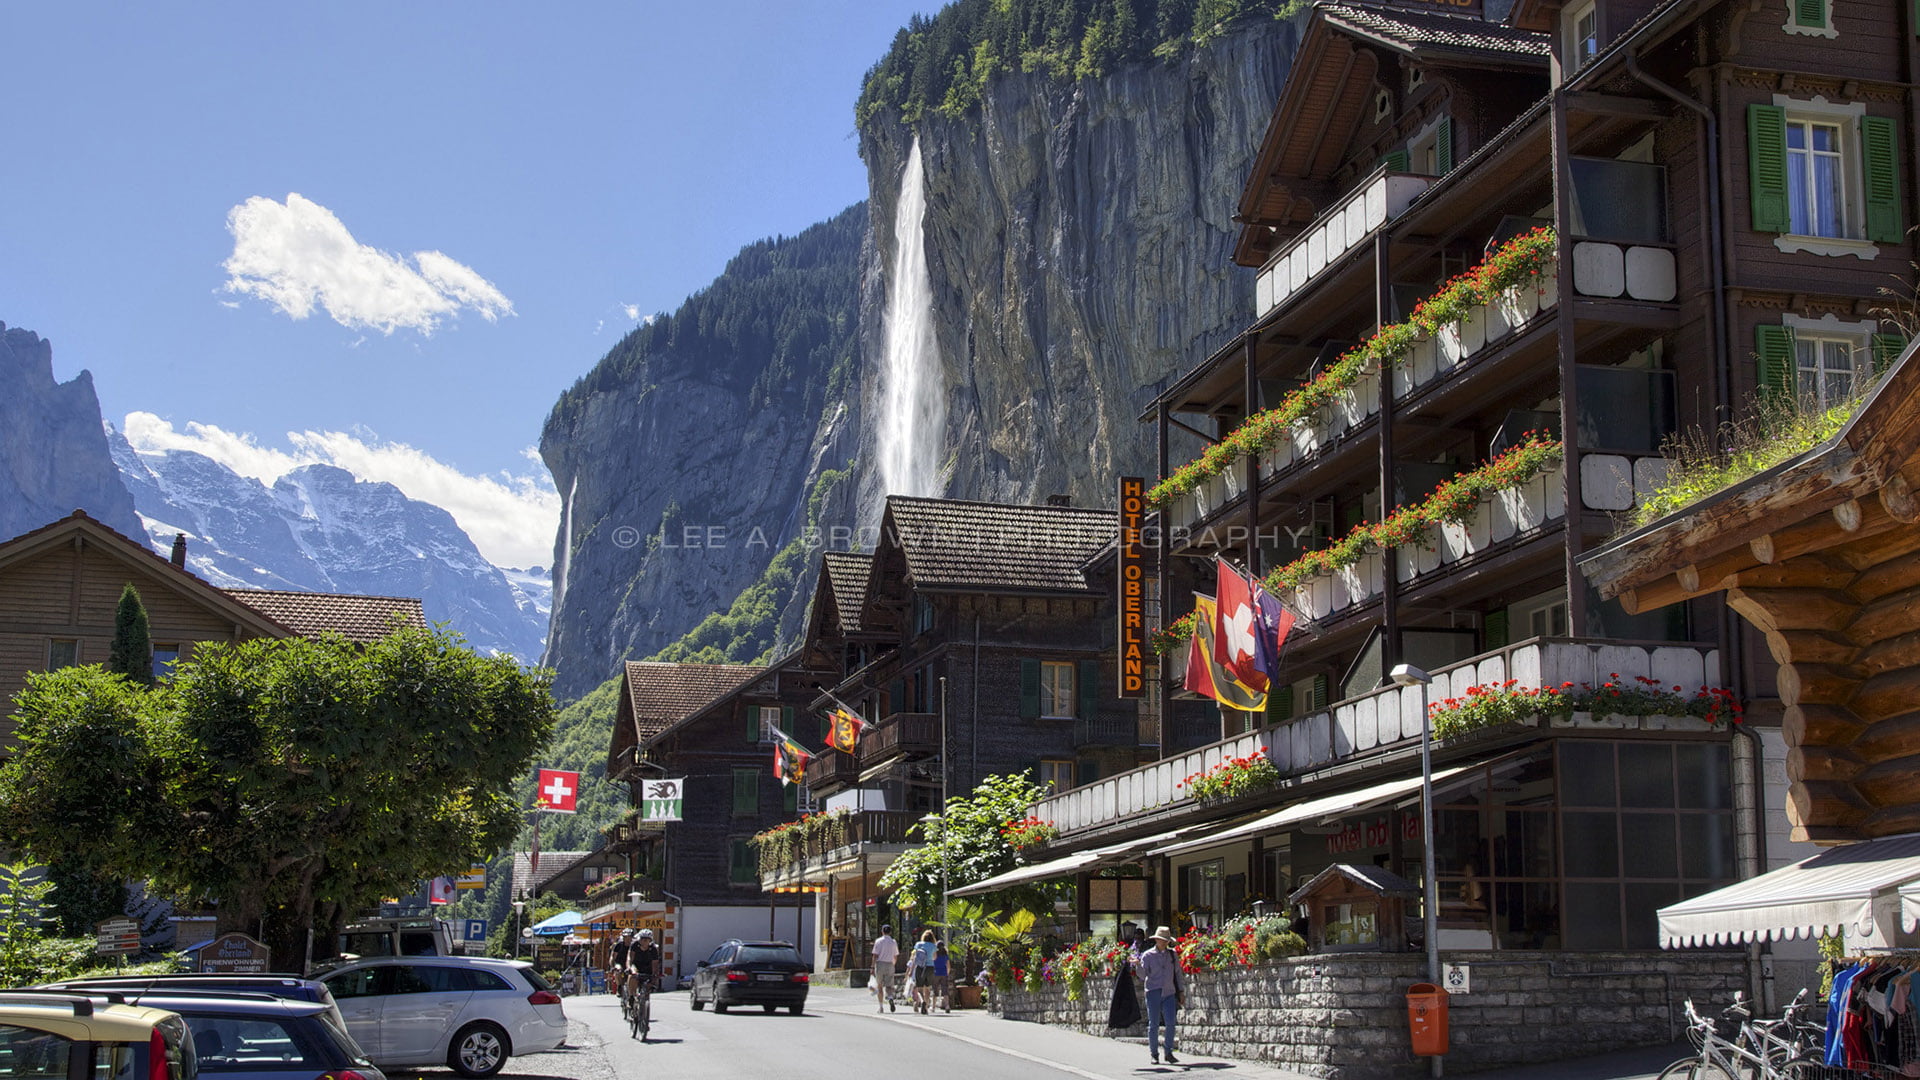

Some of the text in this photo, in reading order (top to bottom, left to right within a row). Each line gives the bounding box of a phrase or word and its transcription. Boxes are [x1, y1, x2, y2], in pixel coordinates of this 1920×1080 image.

[1124, 481, 1142, 691] HOTEL OBERLAND
[470, 922, 482, 939] P
